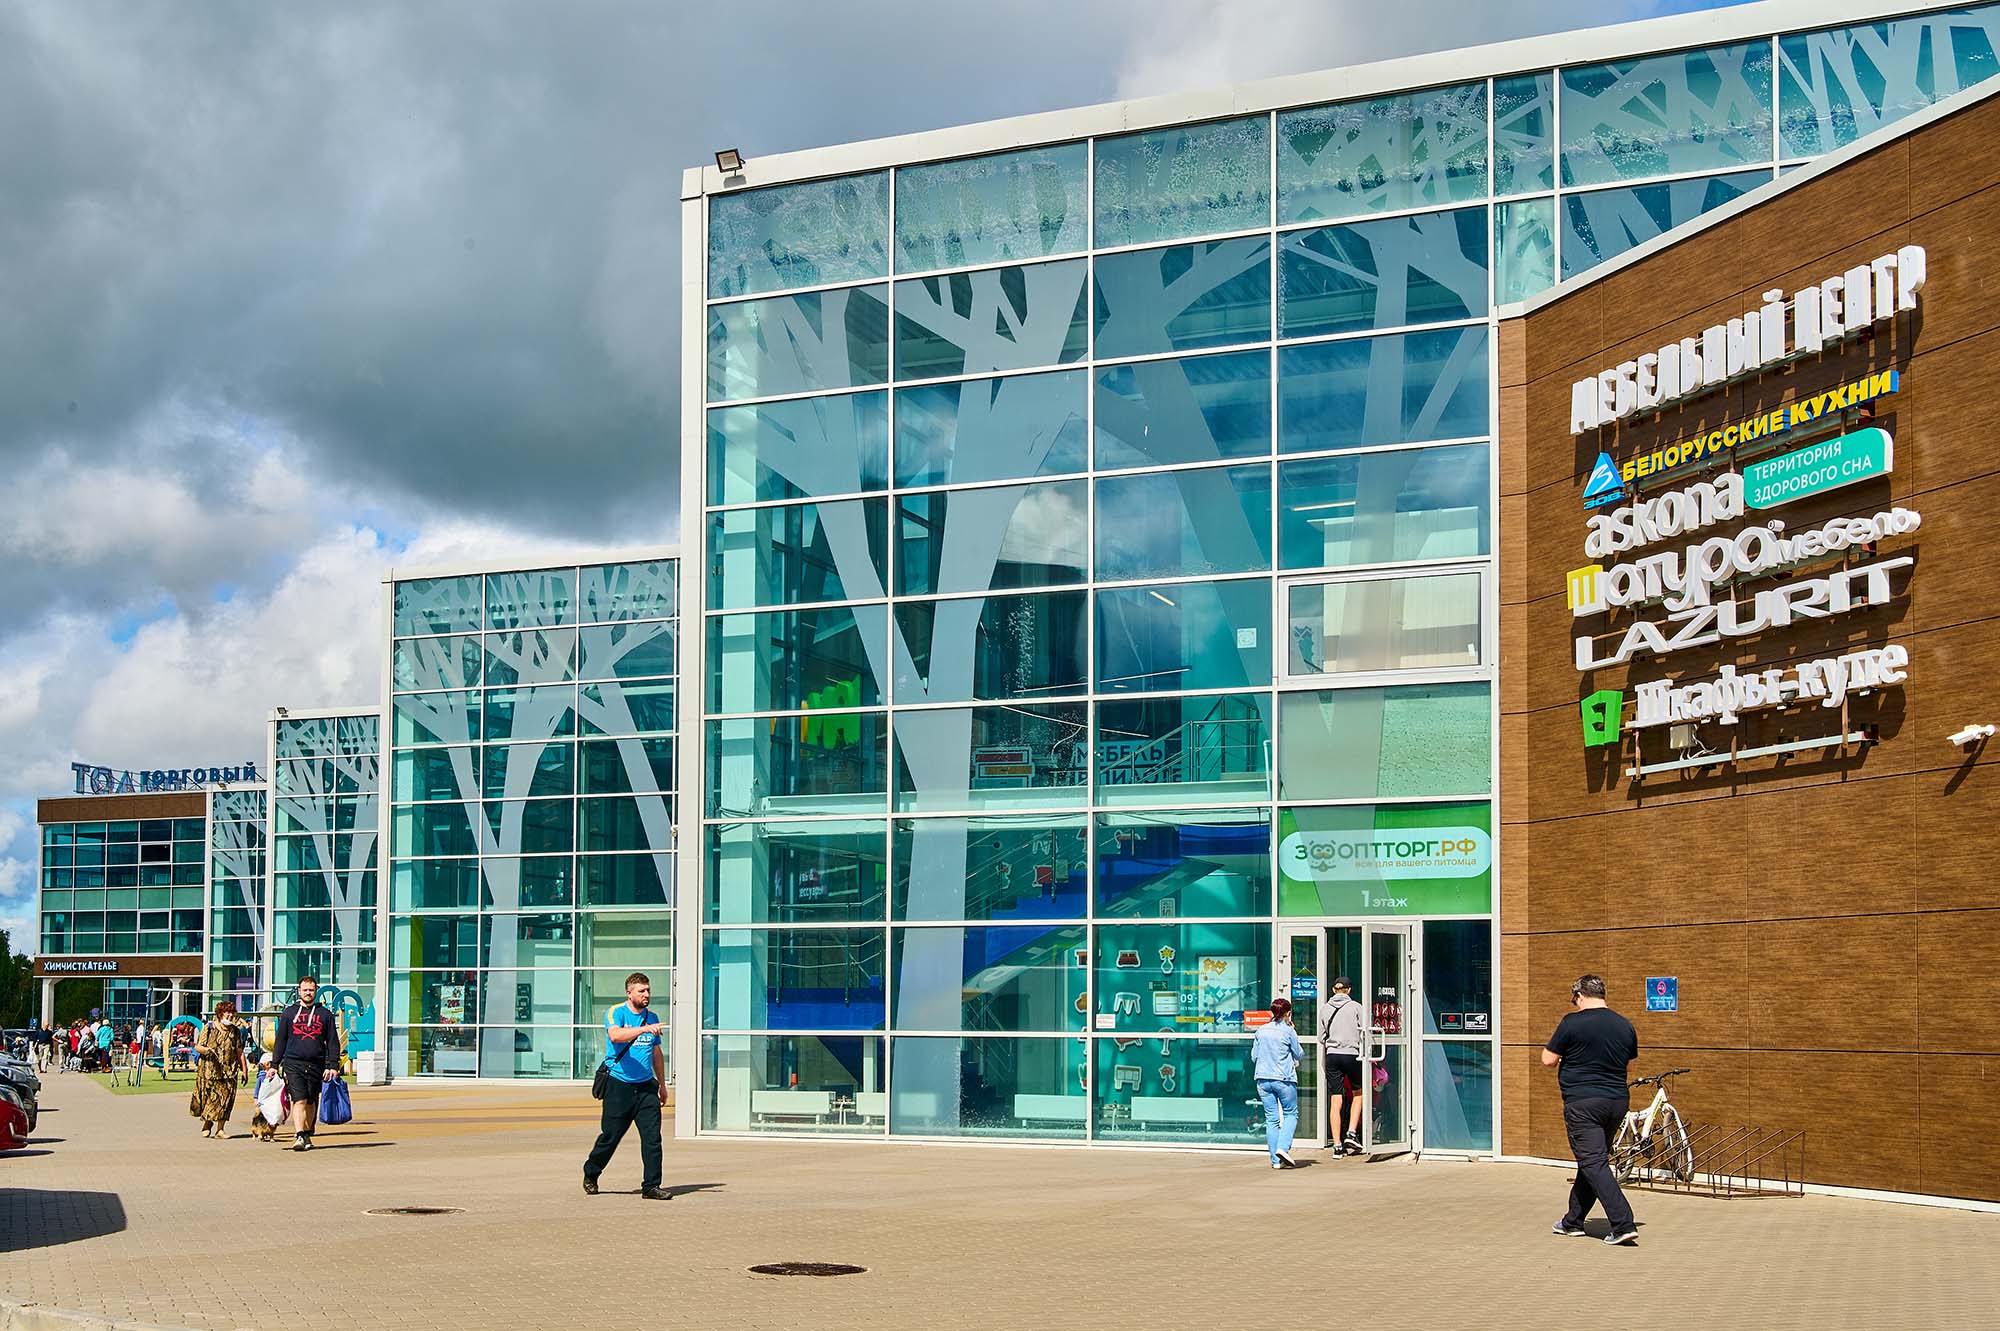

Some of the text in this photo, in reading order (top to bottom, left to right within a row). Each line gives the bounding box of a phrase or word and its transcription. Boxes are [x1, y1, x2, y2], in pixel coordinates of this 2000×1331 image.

[1570, 245, 1926, 435] МЕБЕЛЬНЫЙ ЦЕНТР
[1622, 370, 1898, 484] БЕЛОРУССКИЕ КУХНИ
[1753, 453, 1873, 503] ЗДОРОВОГО СНА
[1754, 440, 1842, 481] ТЕРРИТОРИЯ
[1584, 472, 1744, 558] askona
[1776, 507, 1921, 564] мебель
[1576, 556, 1914, 671] LAZURIT
[1635, 644, 1908, 726] Шкафы-купе
[140, 762, 256, 787] ТОРГОВЫЙ
[1396, 859, 1432, 868] вашего
[1434, 857, 1477, 867] питомца
[1361, 890, 1408, 908] 1 этаж
